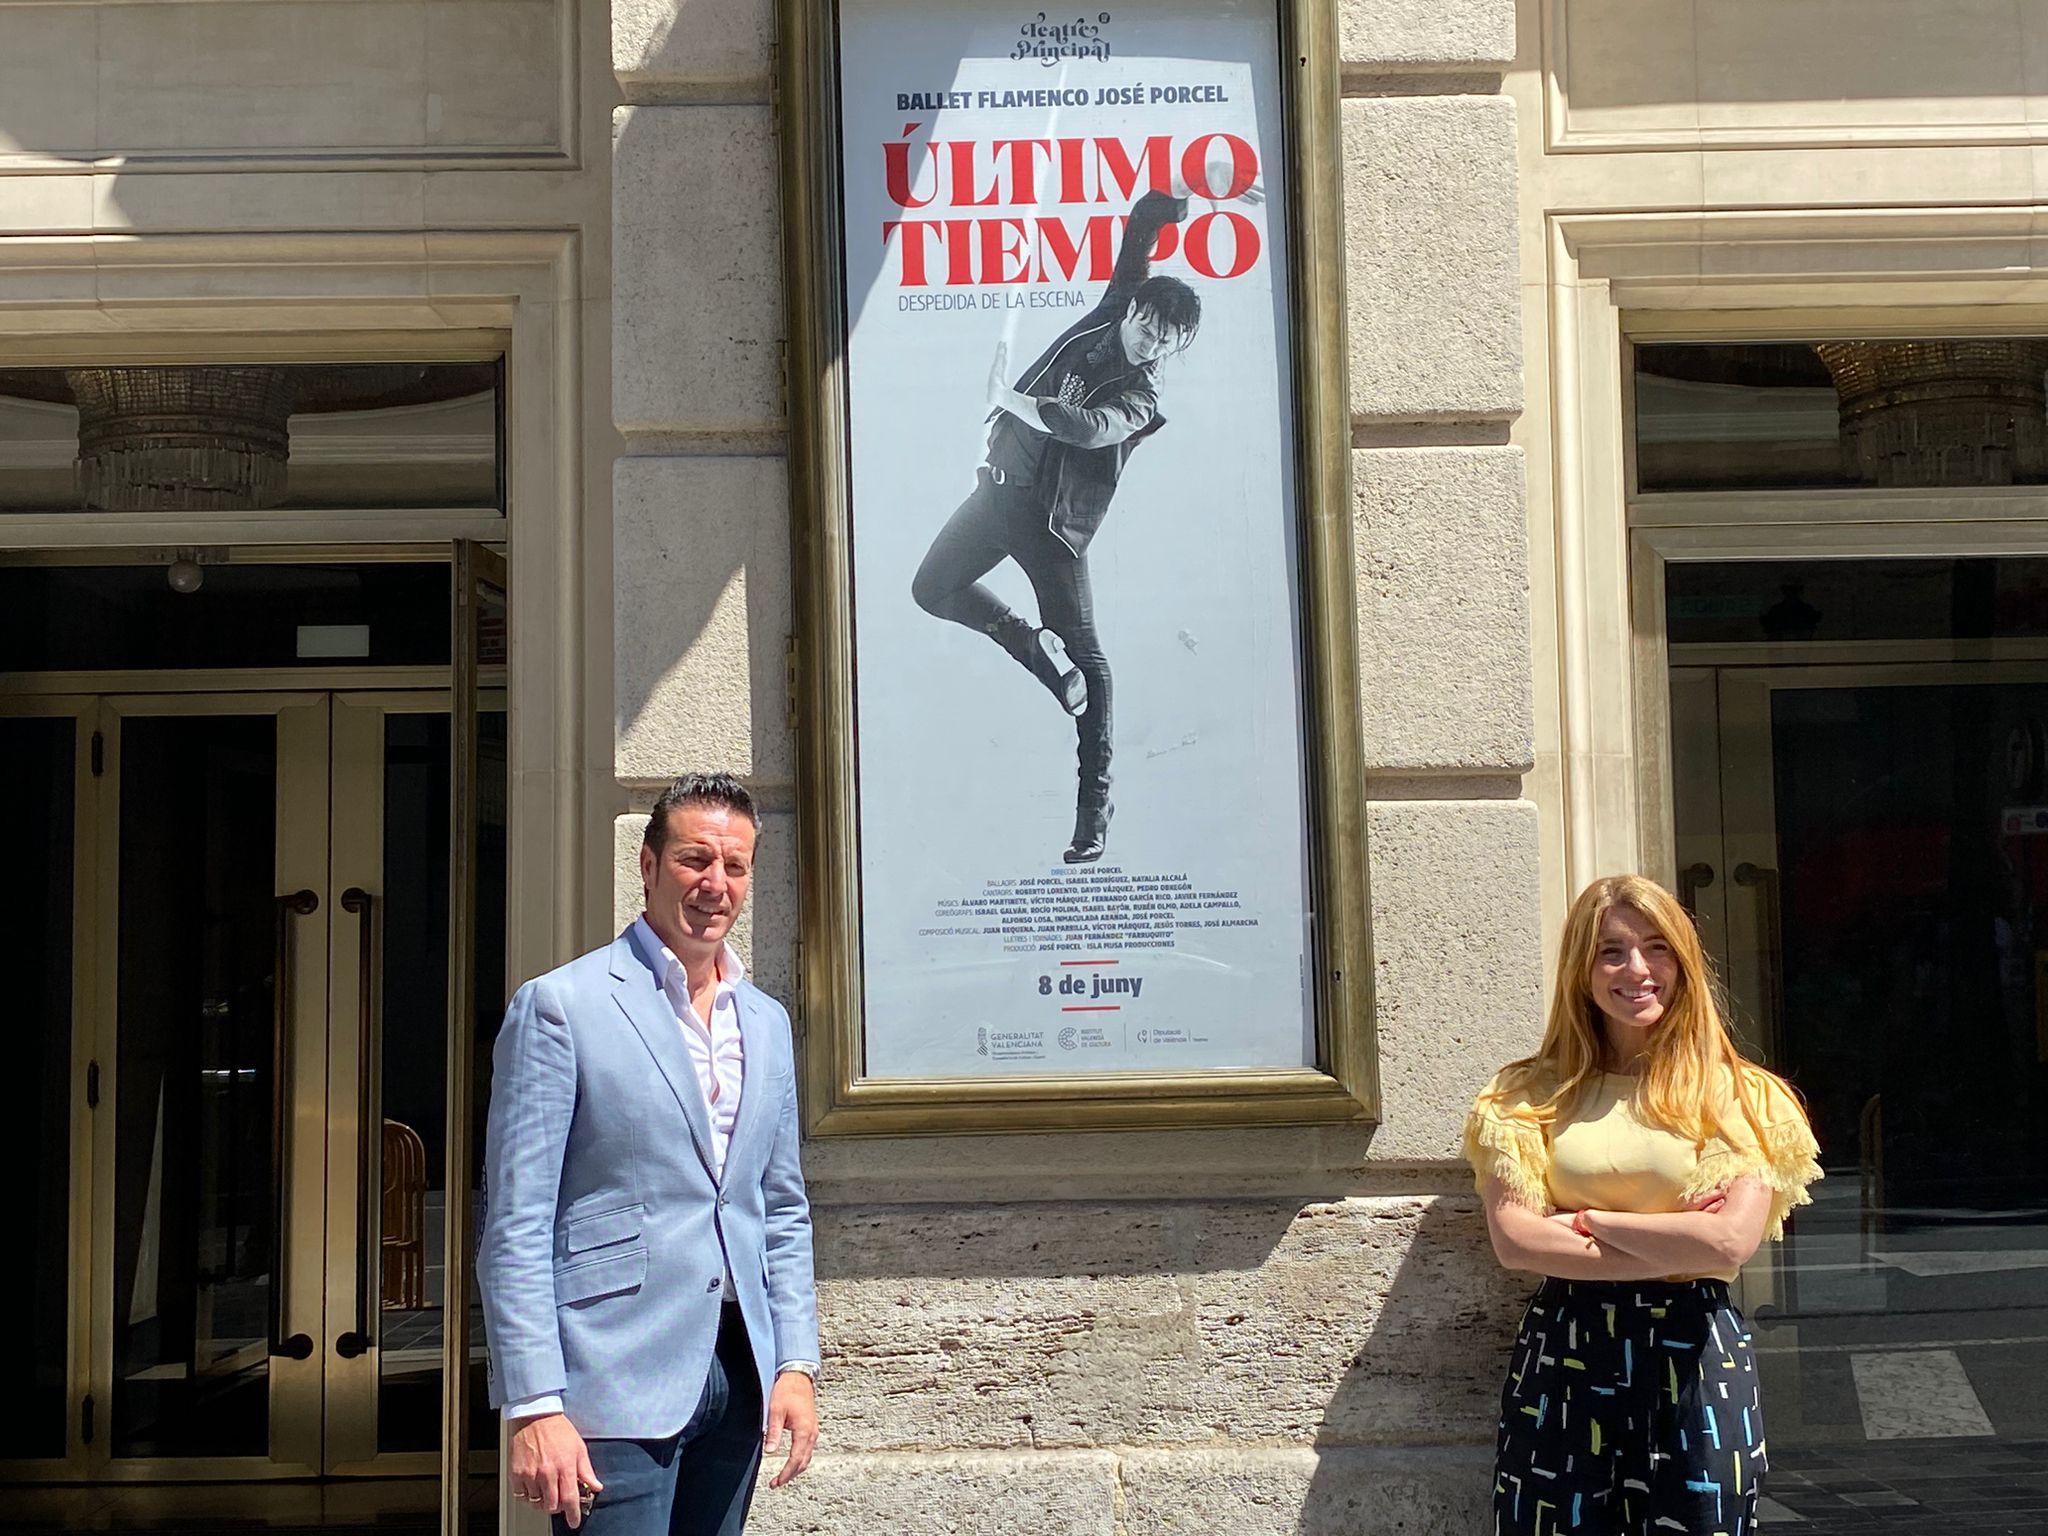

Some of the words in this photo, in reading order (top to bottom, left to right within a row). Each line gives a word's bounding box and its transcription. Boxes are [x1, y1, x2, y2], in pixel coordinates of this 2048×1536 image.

[1021, 12, 1098, 44] Teatre
[1010, 38, 1111, 67] Principal
[897, 92, 972, 110] BALLET
[978, 89, 1088, 108] FLAMENCO
[1094, 82, 1144, 106] JOSÉ
[1150, 86, 1228, 104] PORCEL
[883, 123, 1258, 208] ÚLTIMO
[899, 294, 976, 311] DESPEDIDA
[982, 293, 1000, 309] DE
[1005, 292, 1025, 309] LA
[1030, 291, 1085, 308] ESCENA
[1161, 873, 1187, 881] ALCALÁ
[962, 898, 987, 906] ÁLVARO
[1031, 896, 1054, 904] VÍCTOR
[1199, 891, 1238, 899] FERNÁNDEZ
[1133, 902, 1155, 910] RUBÉN
[1092, 922, 1116, 930] VÍCTOR
[1154, 920, 1173, 928] JESÚS
[1039, 943, 1055, 951] JOSÉ
[1038, 974, 1053, 995] 8
[1059, 974, 1086, 995] de
[1090, 974, 1143, 998] juny
[991, 1032, 1044, 1040] GENERALITAT
